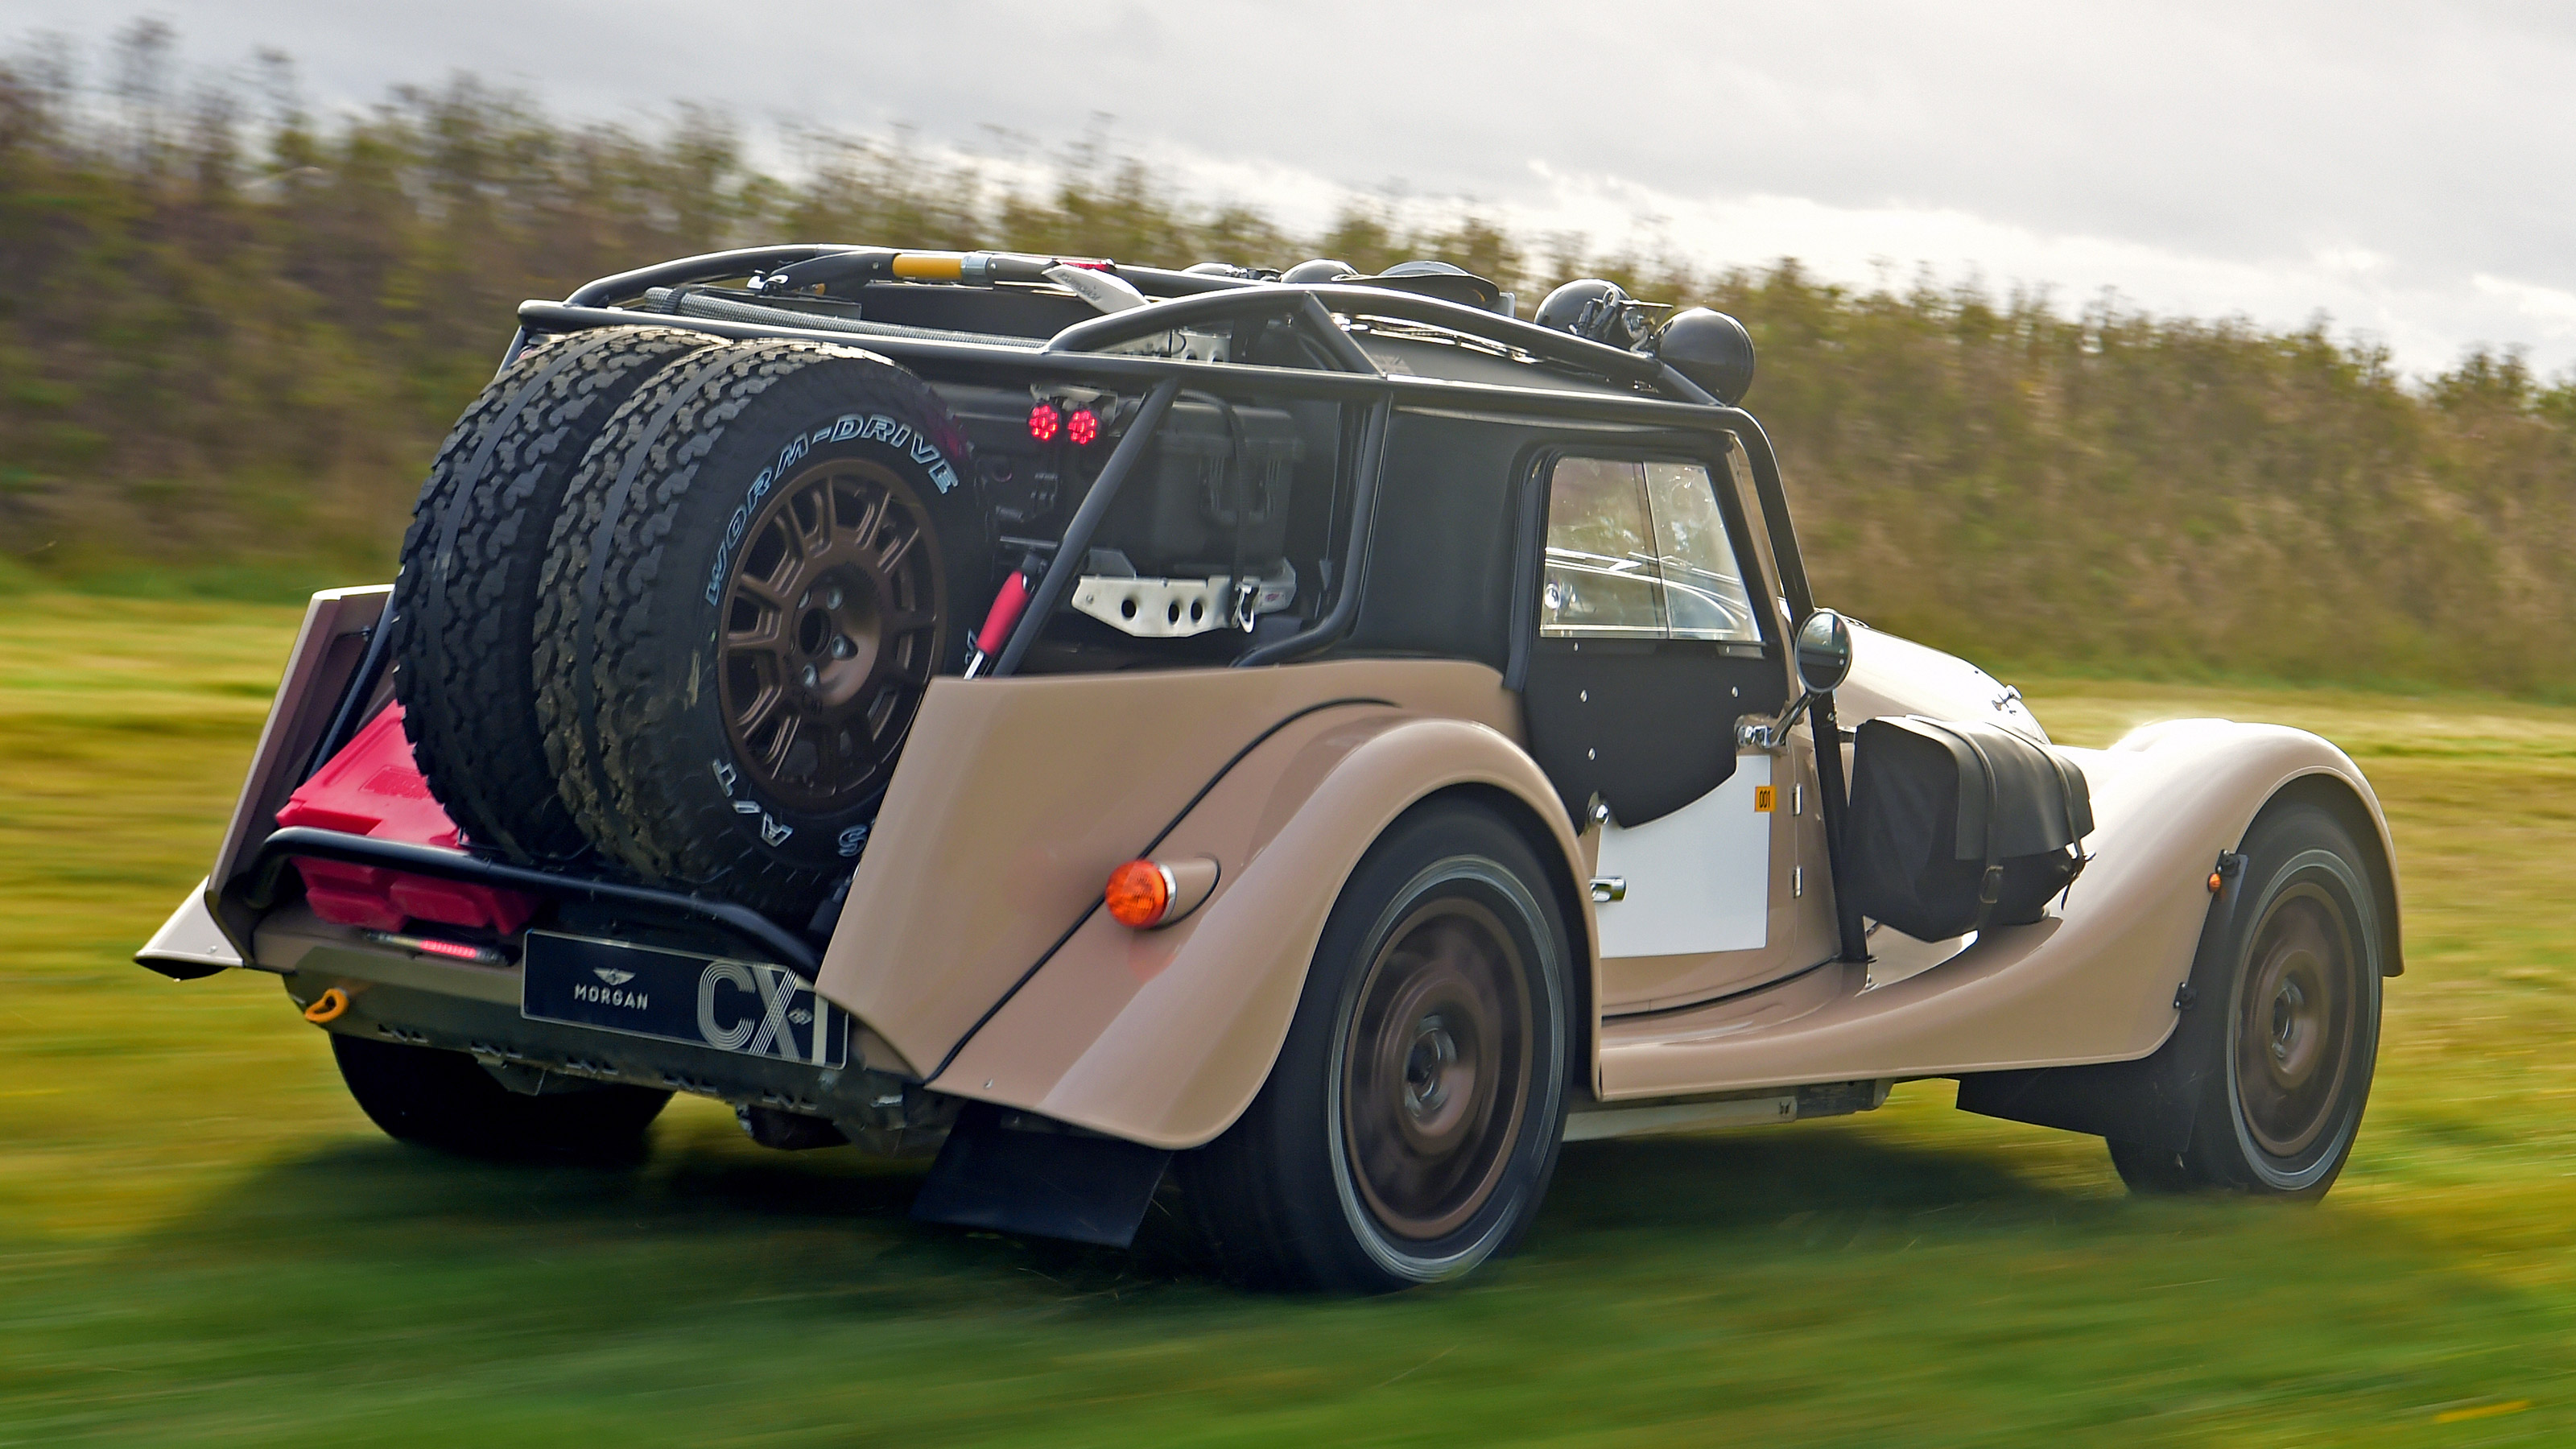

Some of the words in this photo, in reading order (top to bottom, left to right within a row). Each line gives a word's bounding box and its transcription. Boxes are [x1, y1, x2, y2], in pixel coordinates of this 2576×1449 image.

[705, 413, 960, 606] WORM-DRIVE
[1759, 790, 1771, 808] 001
[574, 982, 649, 1011] MORGAN
